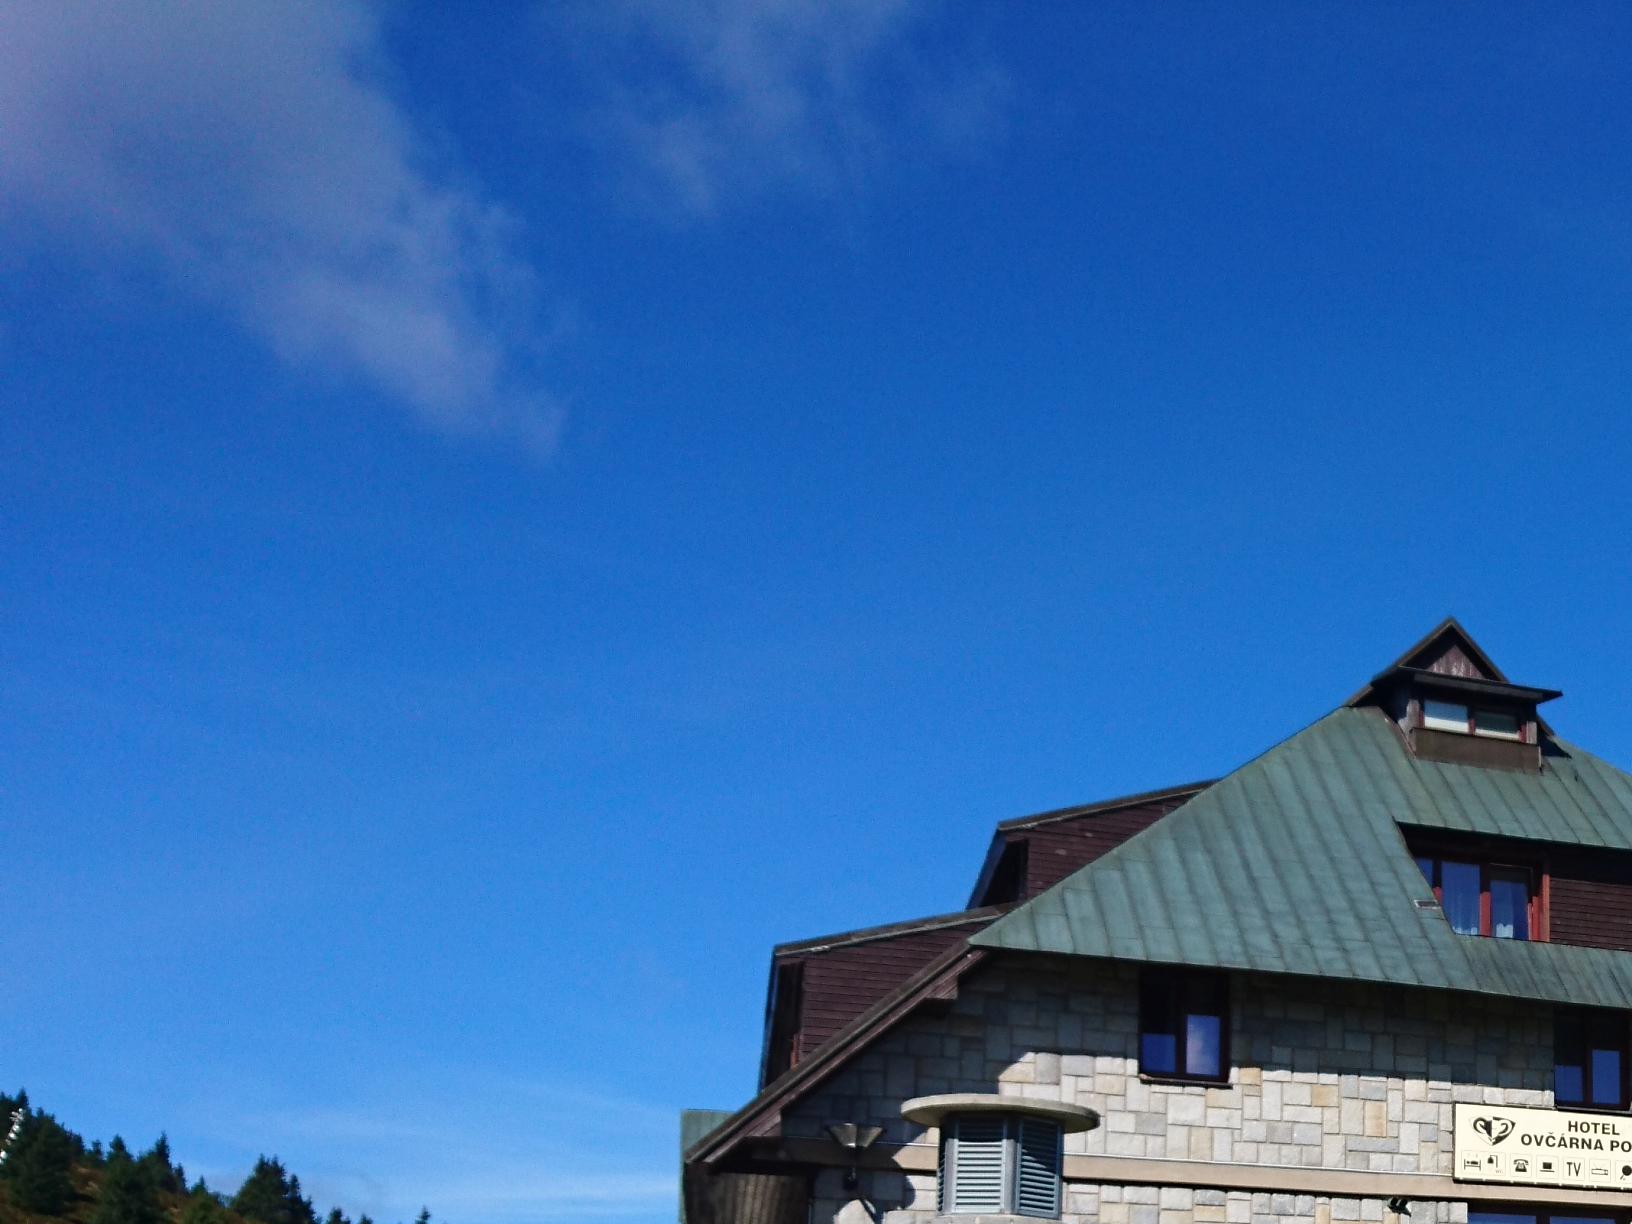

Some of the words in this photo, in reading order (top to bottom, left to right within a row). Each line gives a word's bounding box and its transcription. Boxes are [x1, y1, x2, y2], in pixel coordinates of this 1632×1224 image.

[1567, 1120, 1620, 1136] HOTEL
[1520, 1132, 1604, 1151] OVČÁRNA
[1566, 1161, 1582, 1177] TV
